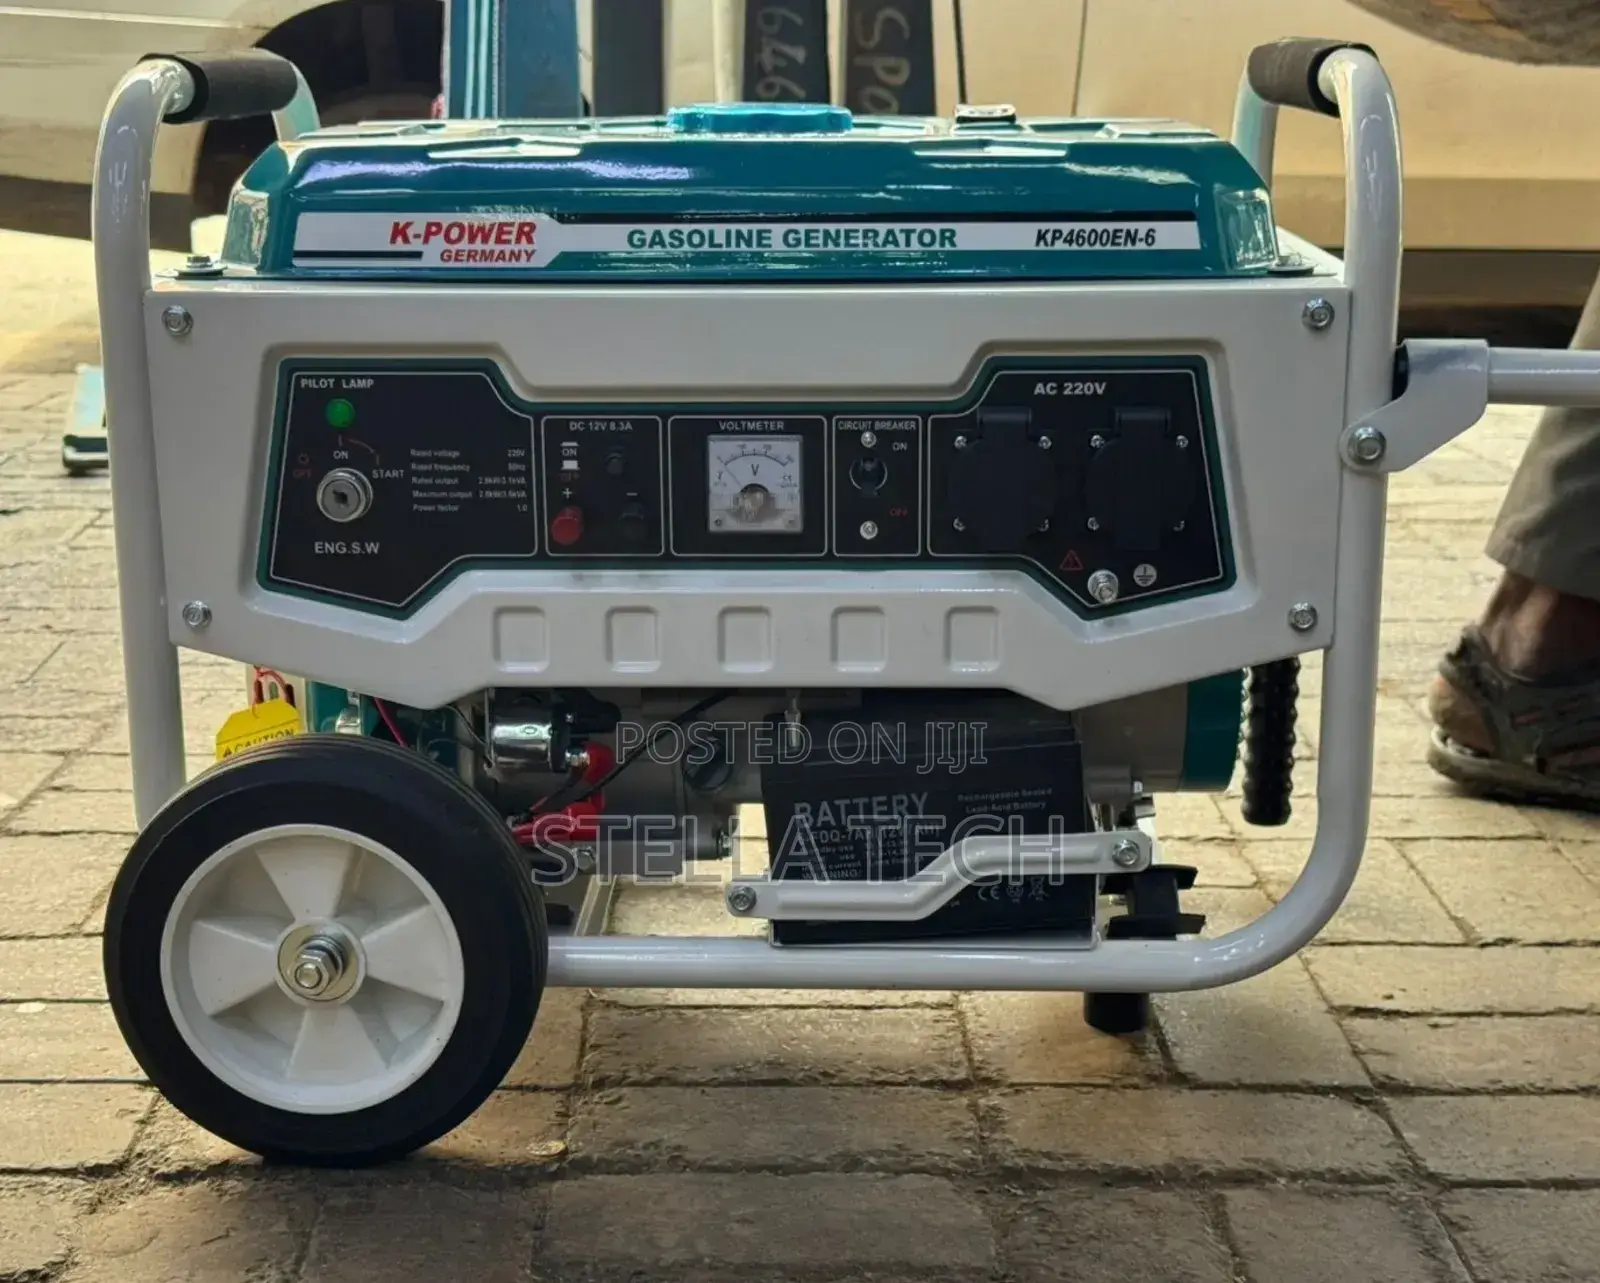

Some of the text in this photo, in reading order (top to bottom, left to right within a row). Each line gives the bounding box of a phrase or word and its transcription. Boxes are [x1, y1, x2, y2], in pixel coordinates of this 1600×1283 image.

[389, 220, 537, 246] K-POWER
[627, 227, 958, 250] GASOLINE GENERATOR
[1034, 227, 1156, 249] KP4600EN-6
[439, 248, 536, 265] GERMANY
[300, 378, 374, 389] PILOT LAMP
[1033, 382, 1107, 396] AC 220V
[569, 421, 585, 431] DC
[589, 420, 607, 431] 12V
[719, 420, 786, 431] VOLTMETER
[837, 420, 916, 431] CIRCUIT BREAKER
[562, 448, 577, 456] ON
[892, 442, 908, 451] ON
[333, 450, 349, 460] ON
[372, 469, 404, 479] START
[750, 463, 760, 477] V
[314, 541, 380, 554] ENG.S.W
[794, 791, 930, 828] BATTERY
